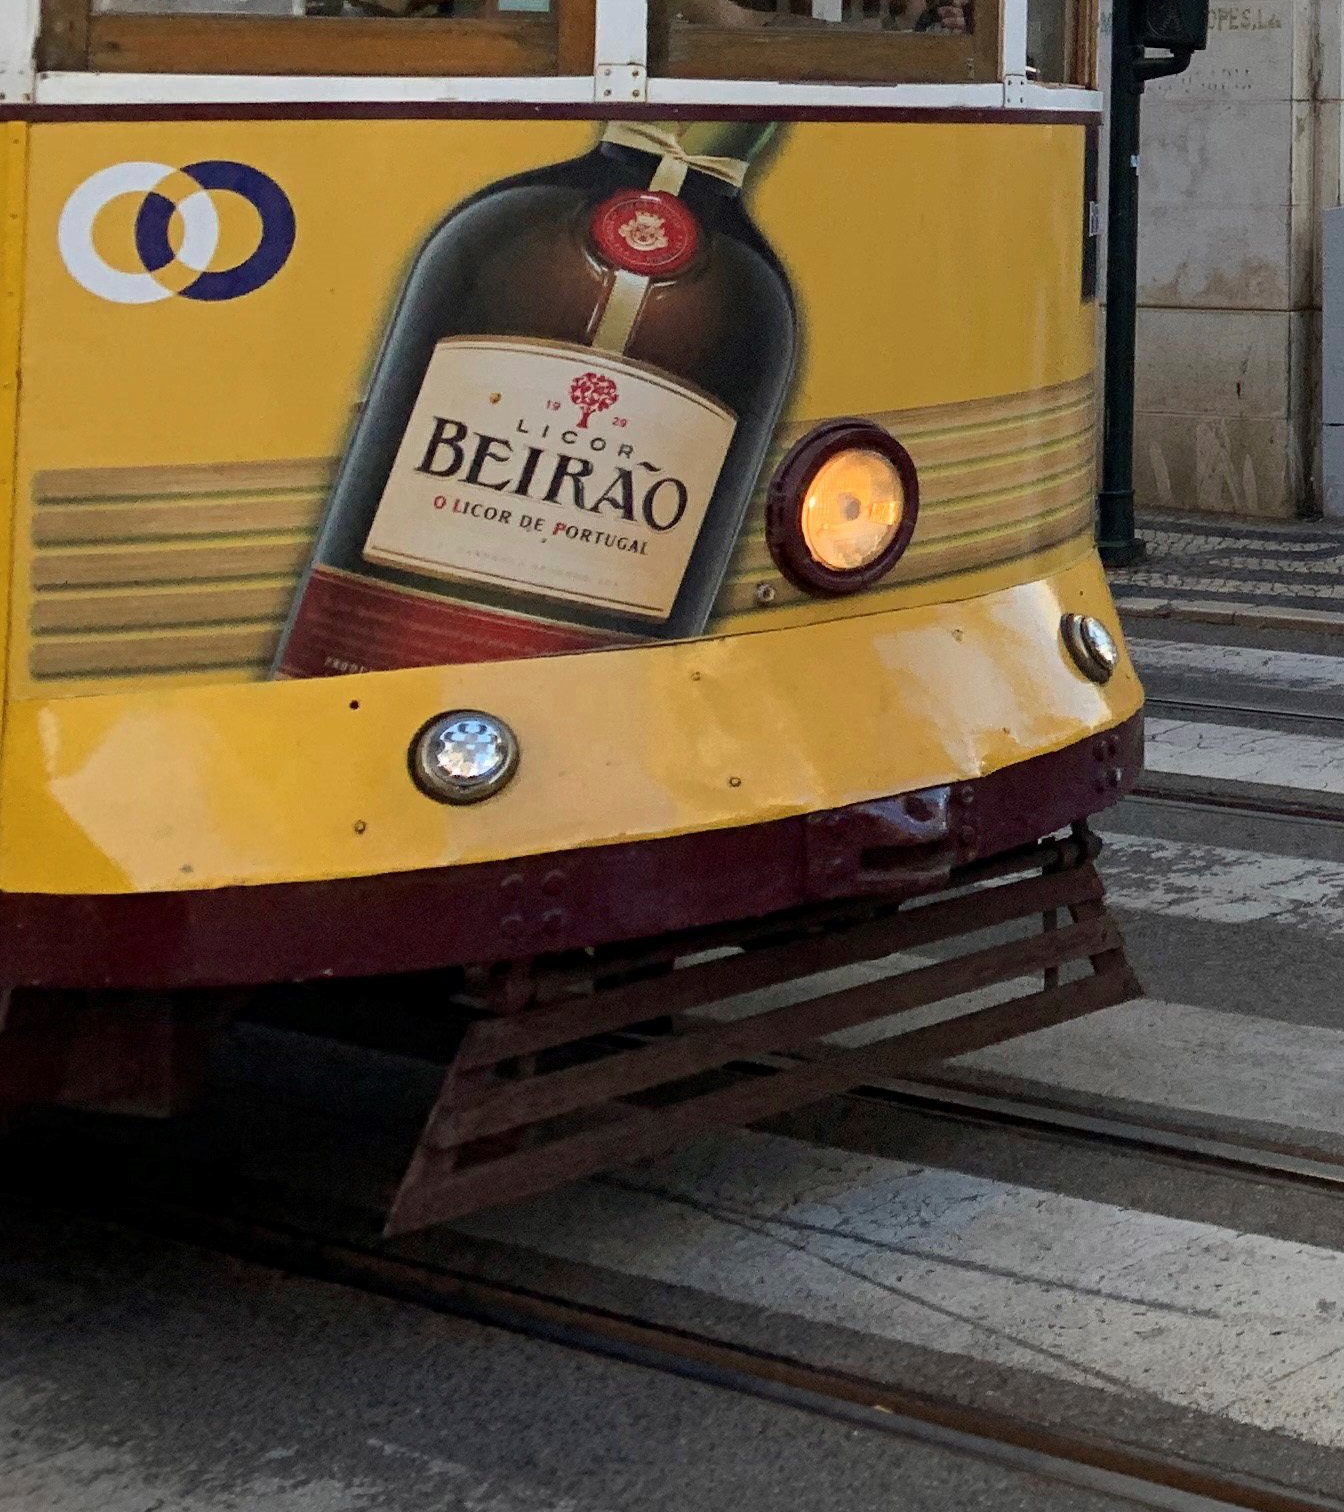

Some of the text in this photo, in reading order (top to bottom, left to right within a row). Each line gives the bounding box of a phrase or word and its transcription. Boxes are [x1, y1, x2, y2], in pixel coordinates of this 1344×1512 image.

[516, 419, 635, 459] LICOR
[546, 399, 627, 428] 19 29
[414, 416, 688, 532] BEIRÃO
[433, 494, 649, 556] O LICOR DE PORTUGAL
